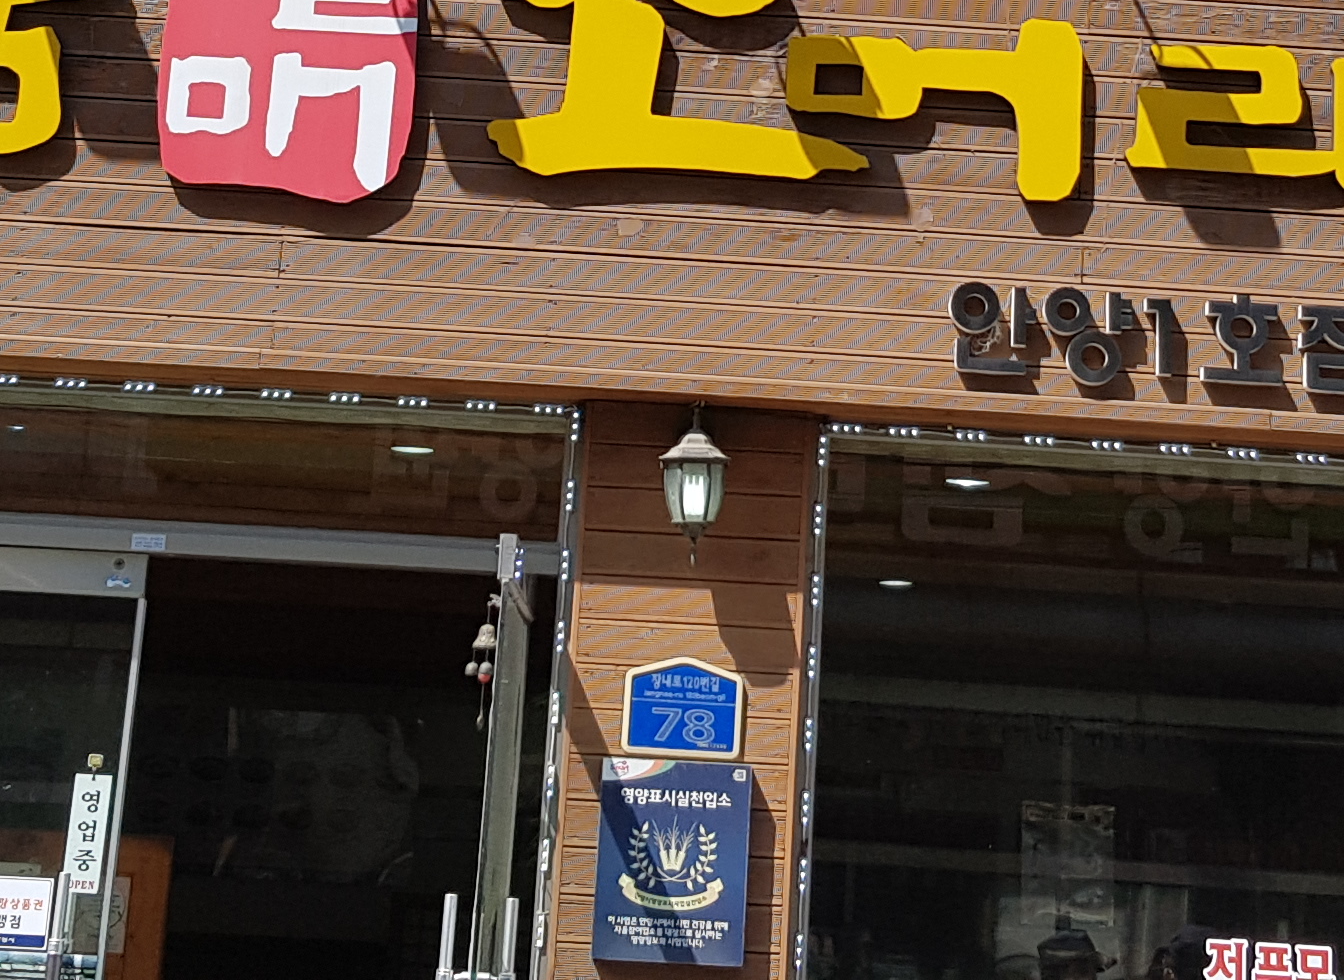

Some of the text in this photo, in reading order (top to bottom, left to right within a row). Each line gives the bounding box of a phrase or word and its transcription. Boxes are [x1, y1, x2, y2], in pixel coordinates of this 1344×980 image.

[652, 707, 715, 744] 78
[621, 786, 732, 808] 영양표시실천업소
[73, 790, 101, 871] 영업중
